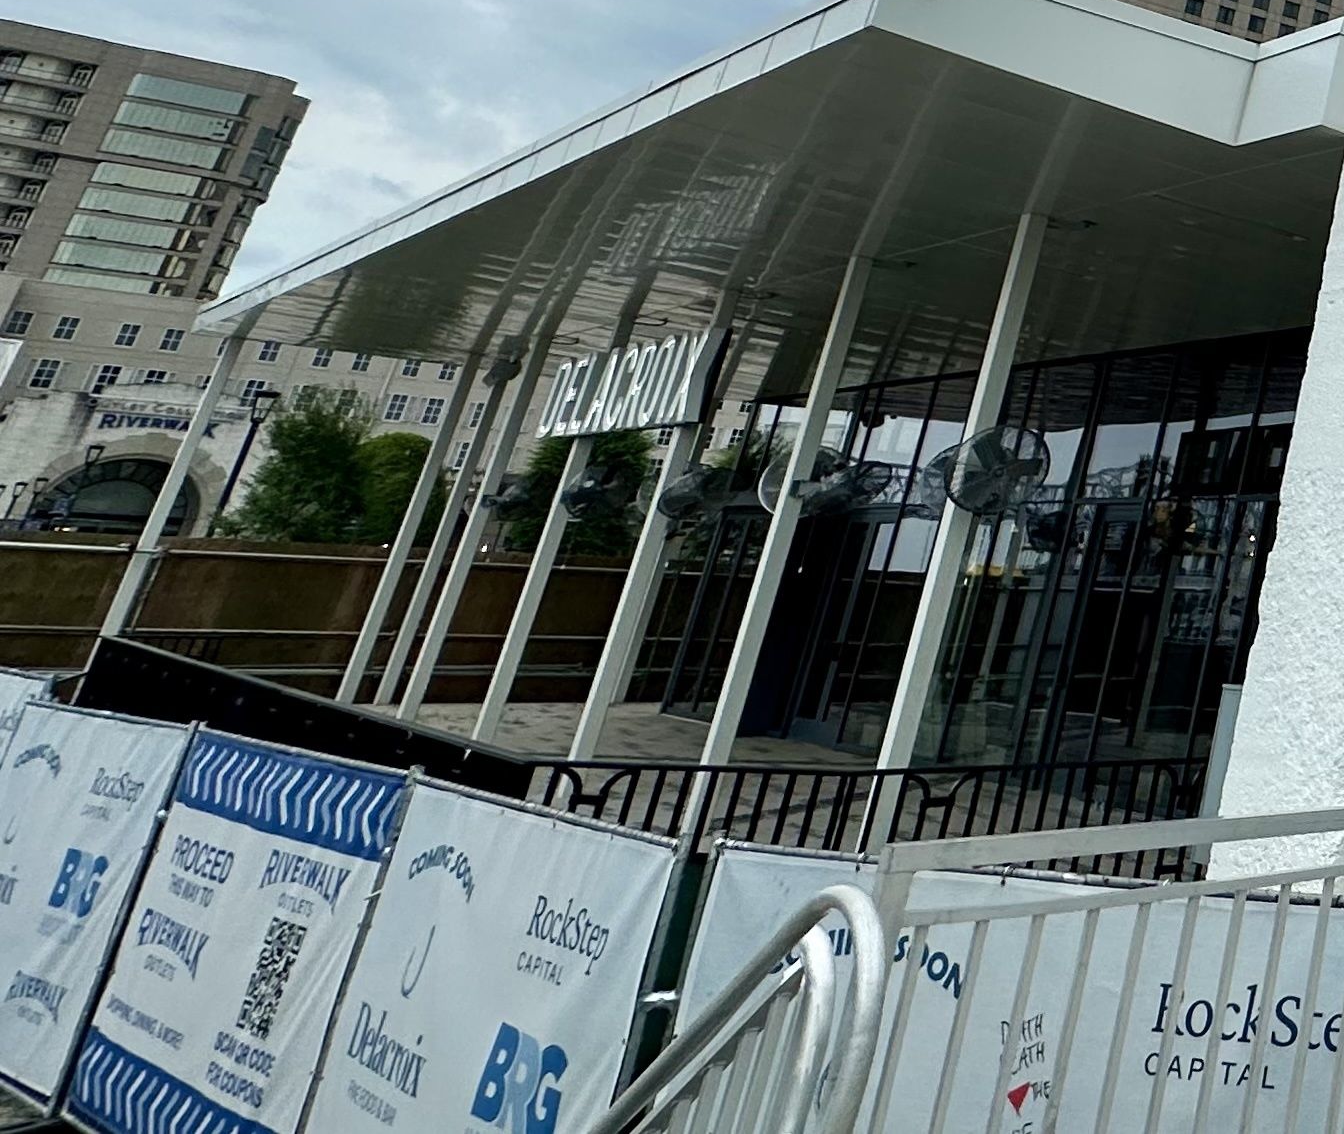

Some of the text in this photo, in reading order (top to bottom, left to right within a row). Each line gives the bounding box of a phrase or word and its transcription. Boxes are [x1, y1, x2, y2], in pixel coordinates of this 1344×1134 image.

[536, 333, 709, 439] DELACROIX
[99, 414, 219, 439] RIVERWAK
[170, 834, 235, 884] PROCEED
[258, 849, 351, 915] RIVERWALK
[137, 907, 210, 982] RIVERWALK
[526, 895, 609, 975] RockStep
[893, 934, 961, 999] SON
[516, 951, 564, 986] CAPITAL
[346, 1001, 427, 1099] Delacroix
[470, 1021, 568, 1134] BRG
[1143, 1052, 1275, 1089] CAPTAL
